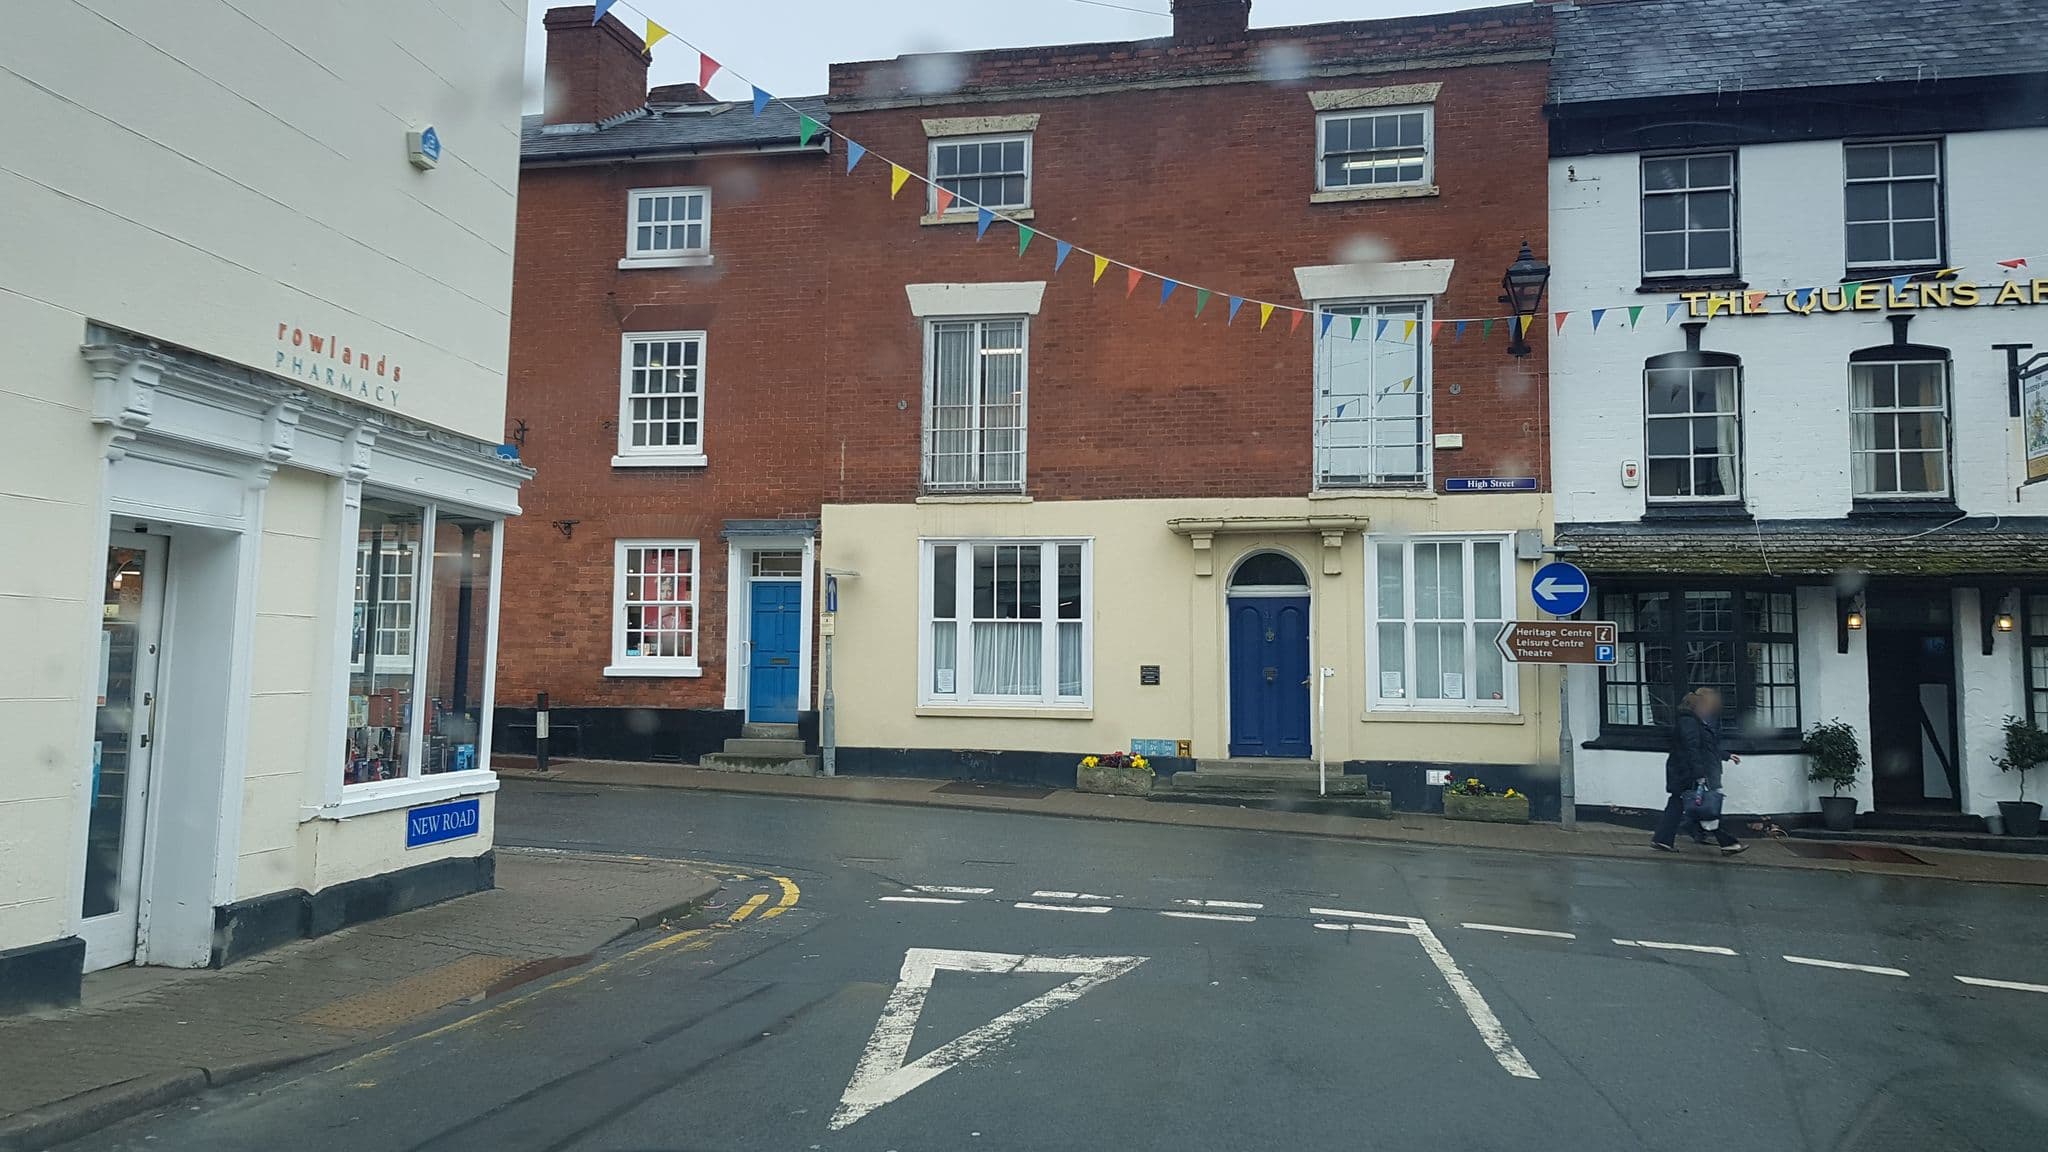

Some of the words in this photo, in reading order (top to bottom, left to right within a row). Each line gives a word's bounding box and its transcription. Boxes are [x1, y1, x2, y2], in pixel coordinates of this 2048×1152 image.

[1681, 290, 1769, 316] THE
[1784, 282, 1981, 315] QUEENS
[277, 322, 401, 382] rowlands
[276, 351, 400, 406] PHARMACY
[1467, 480, 1488, 490] High
[1490, 479, 1515, 488] Street
[1516, 628, 1557, 638] Heritage
[1560, 628, 1592, 637] Centre
[1516, 638, 1550, 647] Leisure
[1552, 639, 1584, 648] Centre
[1516, 648, 1553, 657] Theatre
[1599, 646, 1611, 660] P
[411, 814, 441, 837] NEW
[442, 808, 476, 831] ROAD
